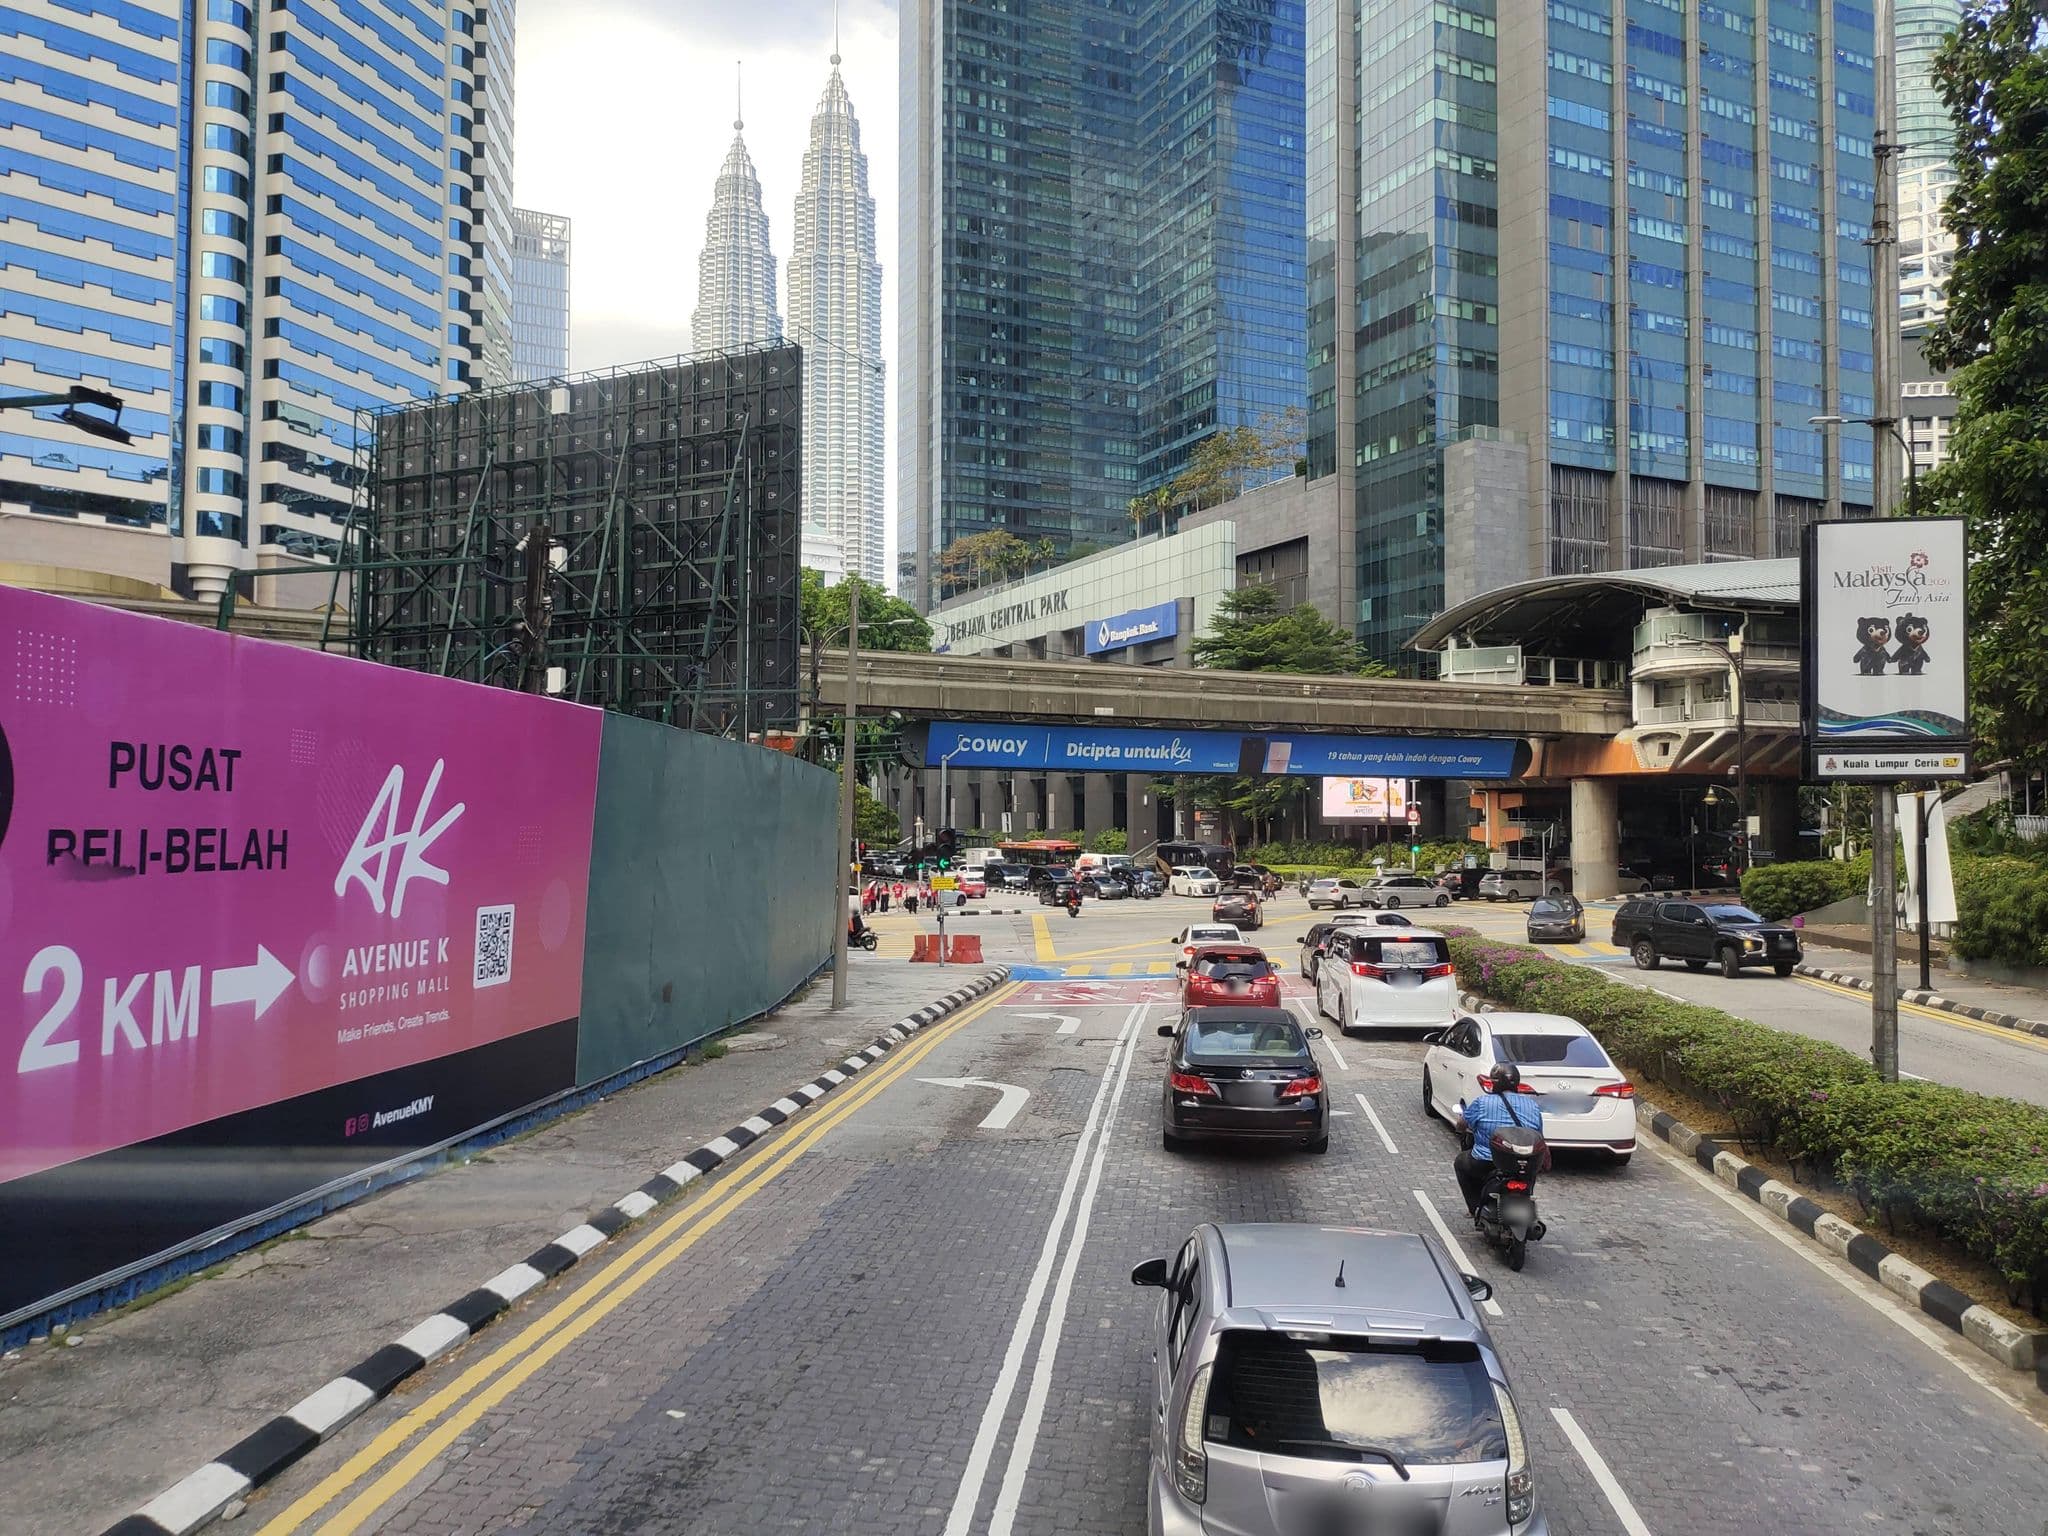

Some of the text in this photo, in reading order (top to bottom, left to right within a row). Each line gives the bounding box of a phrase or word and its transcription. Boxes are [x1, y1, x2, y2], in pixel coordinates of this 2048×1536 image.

[1833, 567, 1926, 591] Malaysia
[1885, 588, 1951, 609] Truly Asia
[950, 589, 1068, 642] BERJAYA CENTRAL PARK
[1110, 621, 1158, 642] Bangkok Bank
[960, 737, 1028, 757] coway
[1066, 742, 1121, 761] Dicipta
[1327, 751, 1483, 765] 19 tahun yang lebih indah dengan Coway
[108, 741, 242, 792] PUSAT
[1843, 759, 1870, 769] Kuala
[1874, 759, 1909, 770] Lumpur
[1914, 758, 1940, 768] Ceria
[342, 937, 450, 978] AVENUE K
[339, 975, 450, 1010] SHOPPING MALL
[17, 945, 202, 1074] 2 KM
[337, 1028, 362, 1044] Make
[363, 1019, 397, 1038] Friends,
[397, 1015, 424, 1030] Create
[372, 1094, 435, 1129] AvenueKMY
